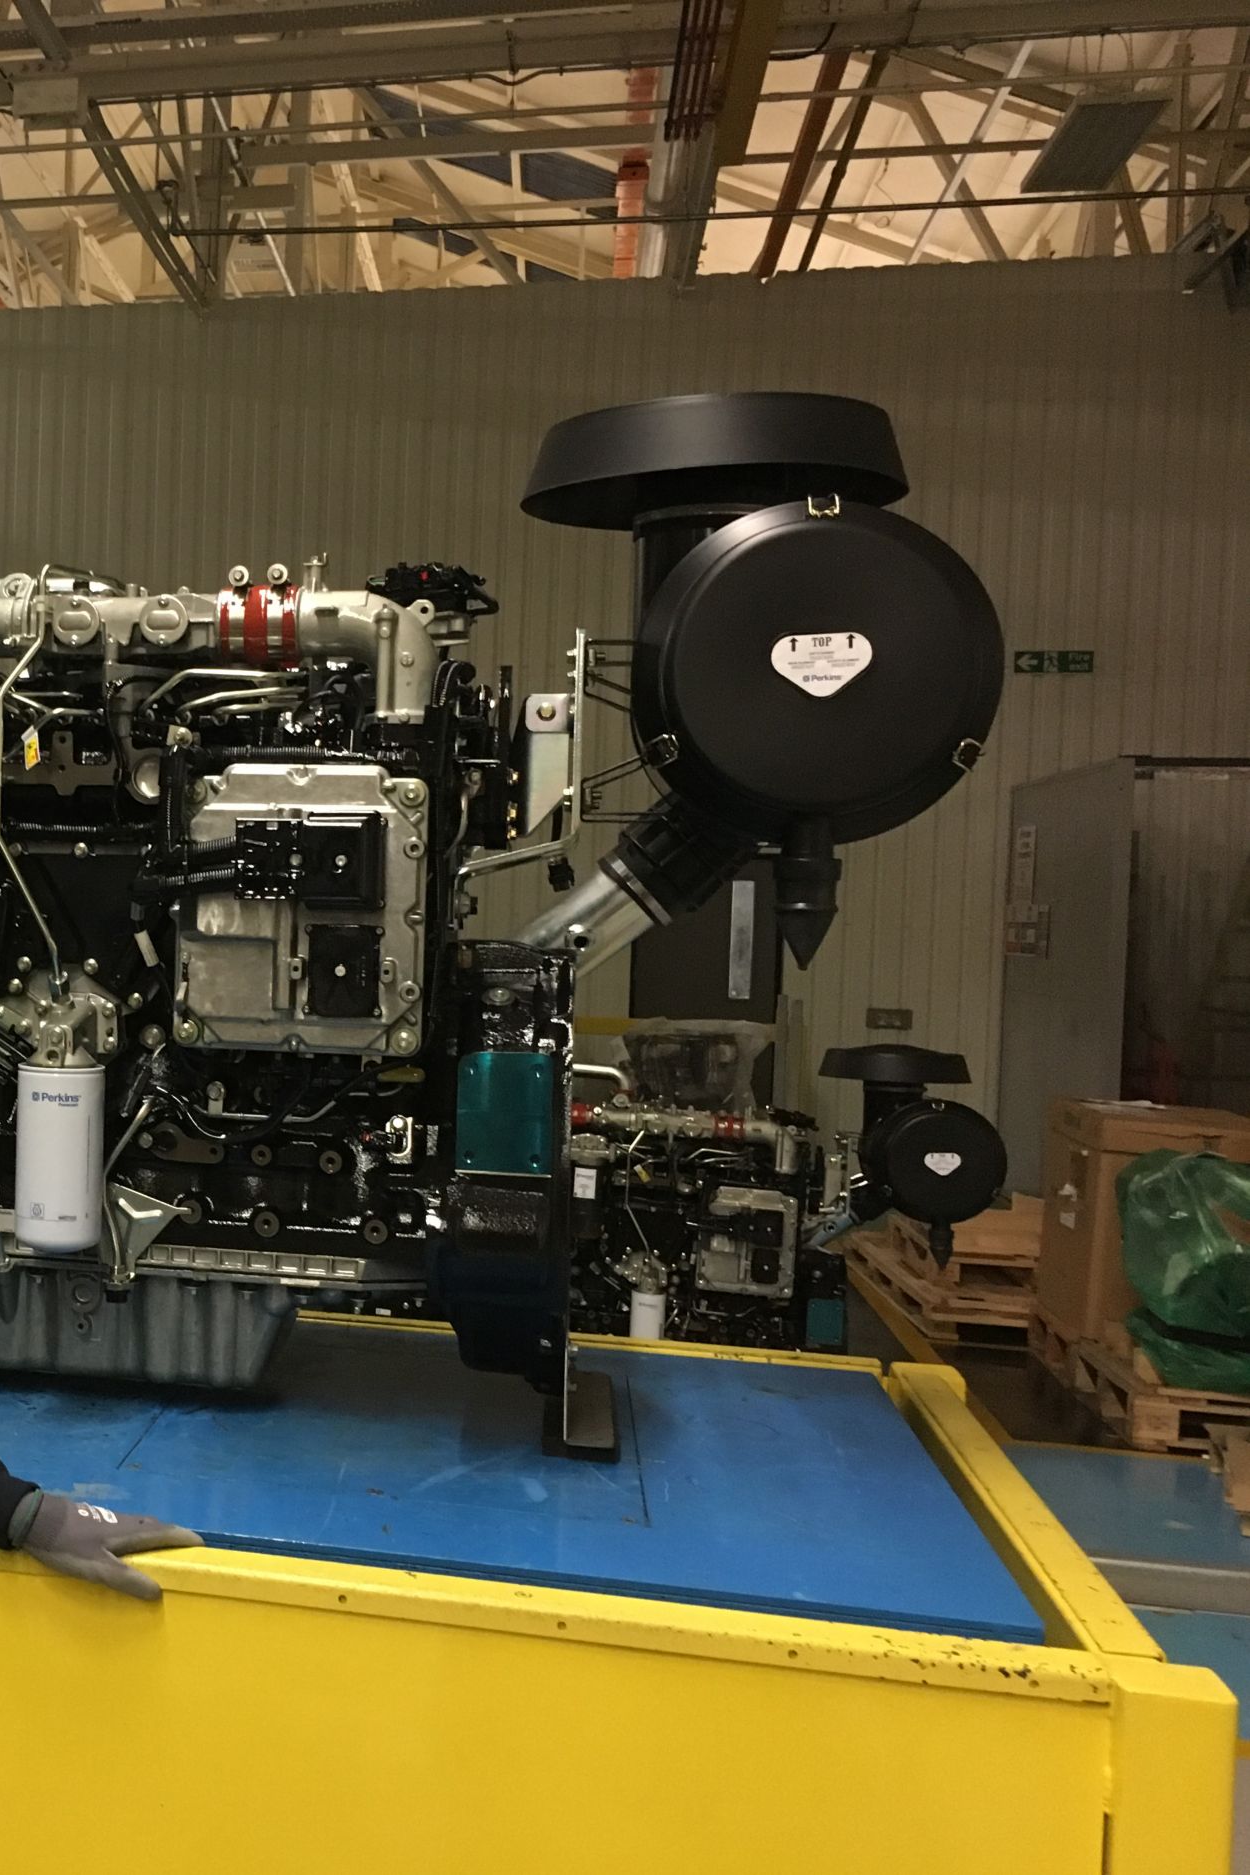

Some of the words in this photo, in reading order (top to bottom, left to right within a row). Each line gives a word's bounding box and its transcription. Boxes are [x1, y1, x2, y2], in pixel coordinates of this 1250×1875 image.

[811, 636, 832, 648] TOP
[811, 674, 842, 682] Perkins
[41, 1092, 79, 1102] Perkins
